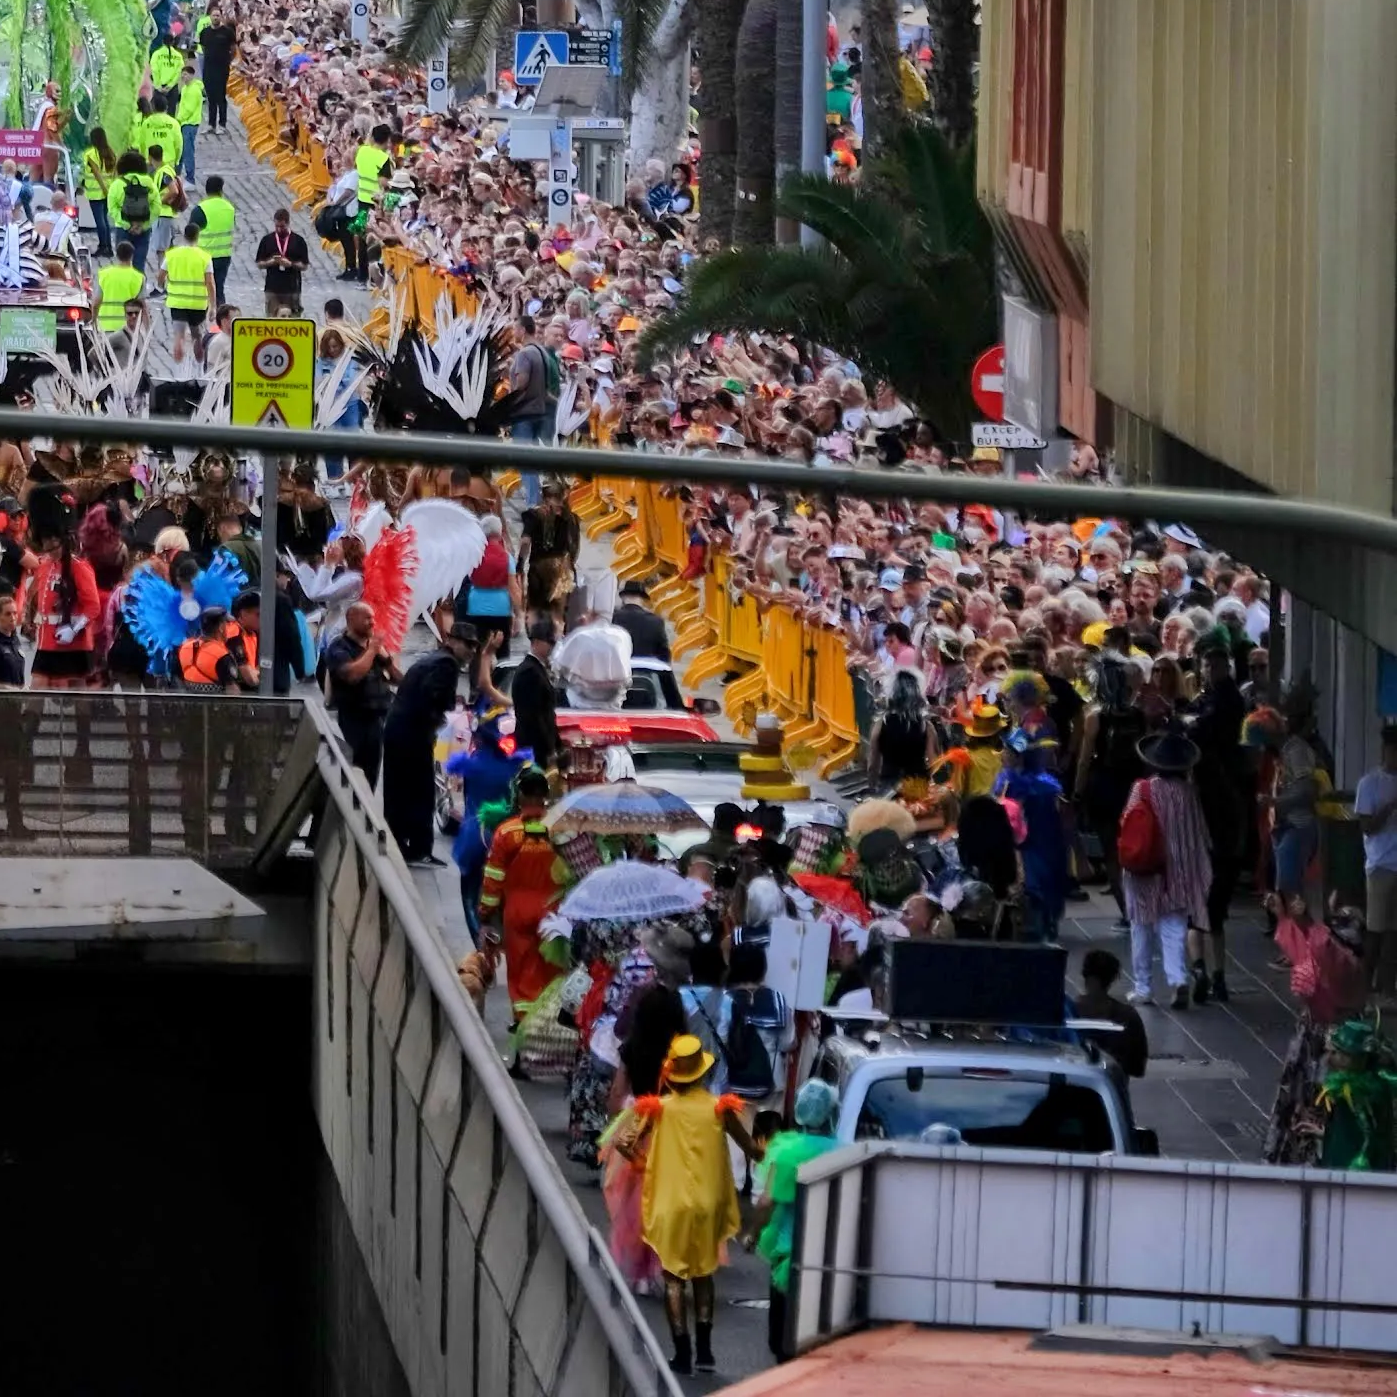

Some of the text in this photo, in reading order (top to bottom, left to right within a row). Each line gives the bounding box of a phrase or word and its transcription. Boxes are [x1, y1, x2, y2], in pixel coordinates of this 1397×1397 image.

[238, 325, 310, 337] ATENCION
[263, 354, 284, 368] 20
[982, 426, 1022, 436] EXCEP
[977, 437, 1001, 446] BUS
[1006, 438, 1013, 447] Y
